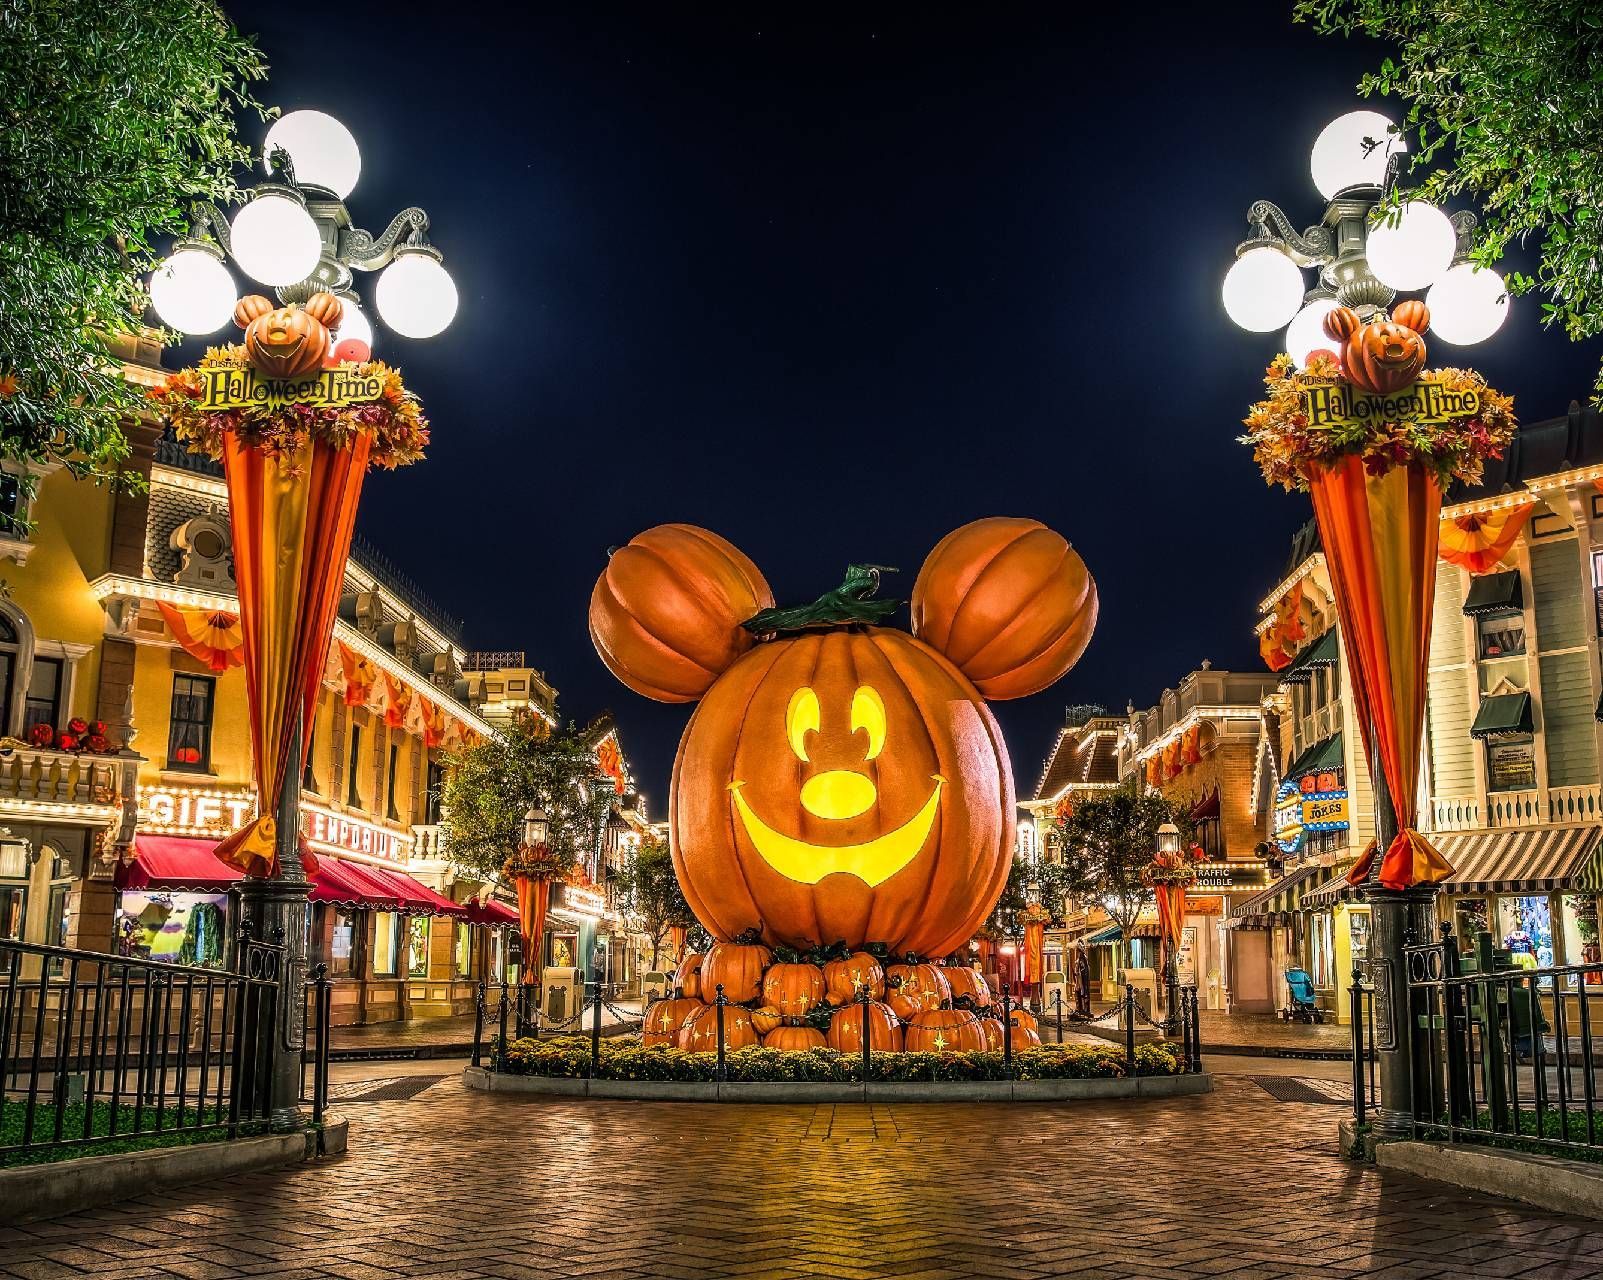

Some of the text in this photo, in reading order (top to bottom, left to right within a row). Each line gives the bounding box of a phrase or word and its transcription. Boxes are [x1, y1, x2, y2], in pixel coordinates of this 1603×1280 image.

[148, 794, 250, 829] GIFT
[1309, 803, 1342, 820] JOKES
[315, 812, 399, 861] EMPORIUM
